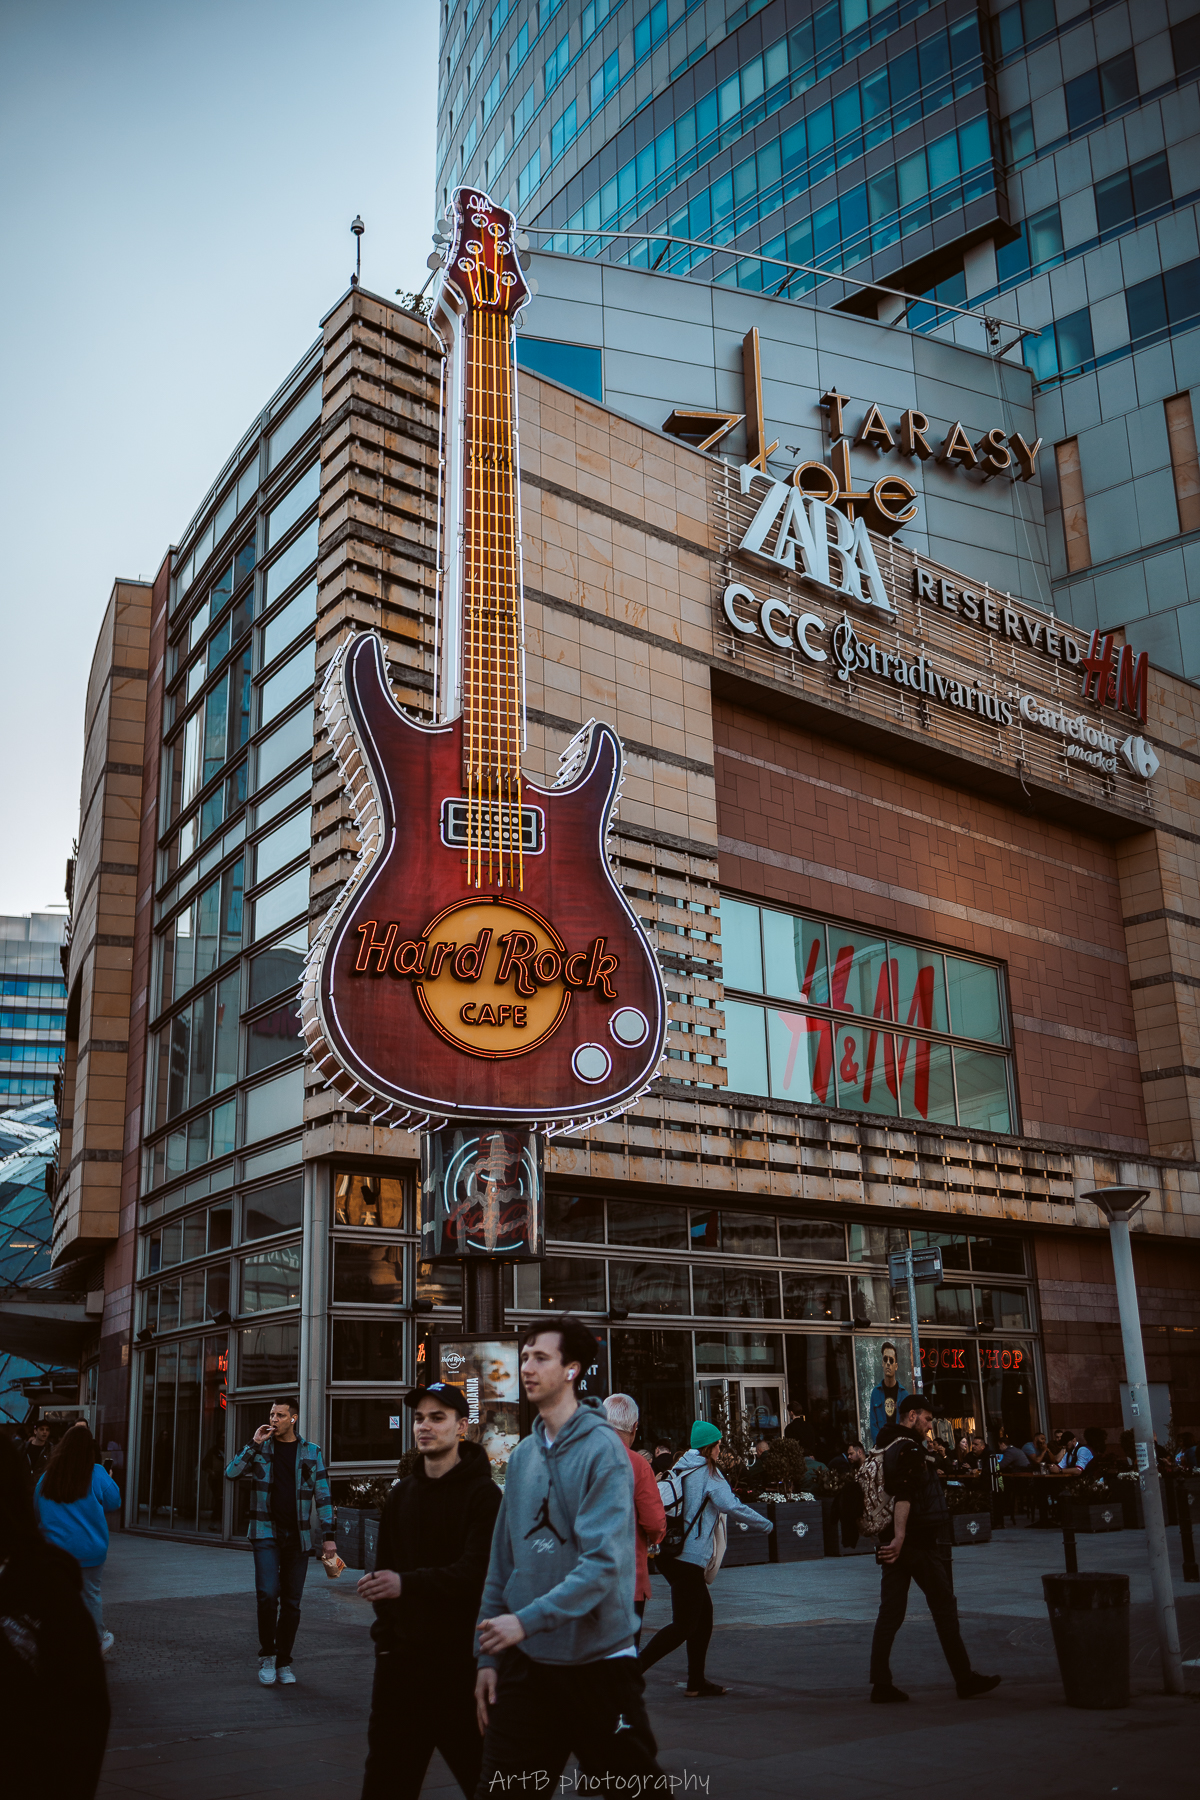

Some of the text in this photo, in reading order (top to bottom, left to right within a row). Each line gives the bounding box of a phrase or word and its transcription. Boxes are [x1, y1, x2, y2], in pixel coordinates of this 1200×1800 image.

[820, 390, 1043, 483] TARASY
[738, 464, 899, 615] ZARA
[722, 582, 828, 662] CCC
[913, 566, 1080, 665] RESERVED
[1081, 628, 1149, 726] H&M
[1019, 694, 1118, 755] Carrefour
[1067, 743, 1119, 774] market
[354, 920, 620, 1001] Hard Rock
[460, 1002, 528, 1027] CAFE
[777, 938, 935, 1121] H&M
[919, 1347, 1023, 1369] ROCK SHOP
